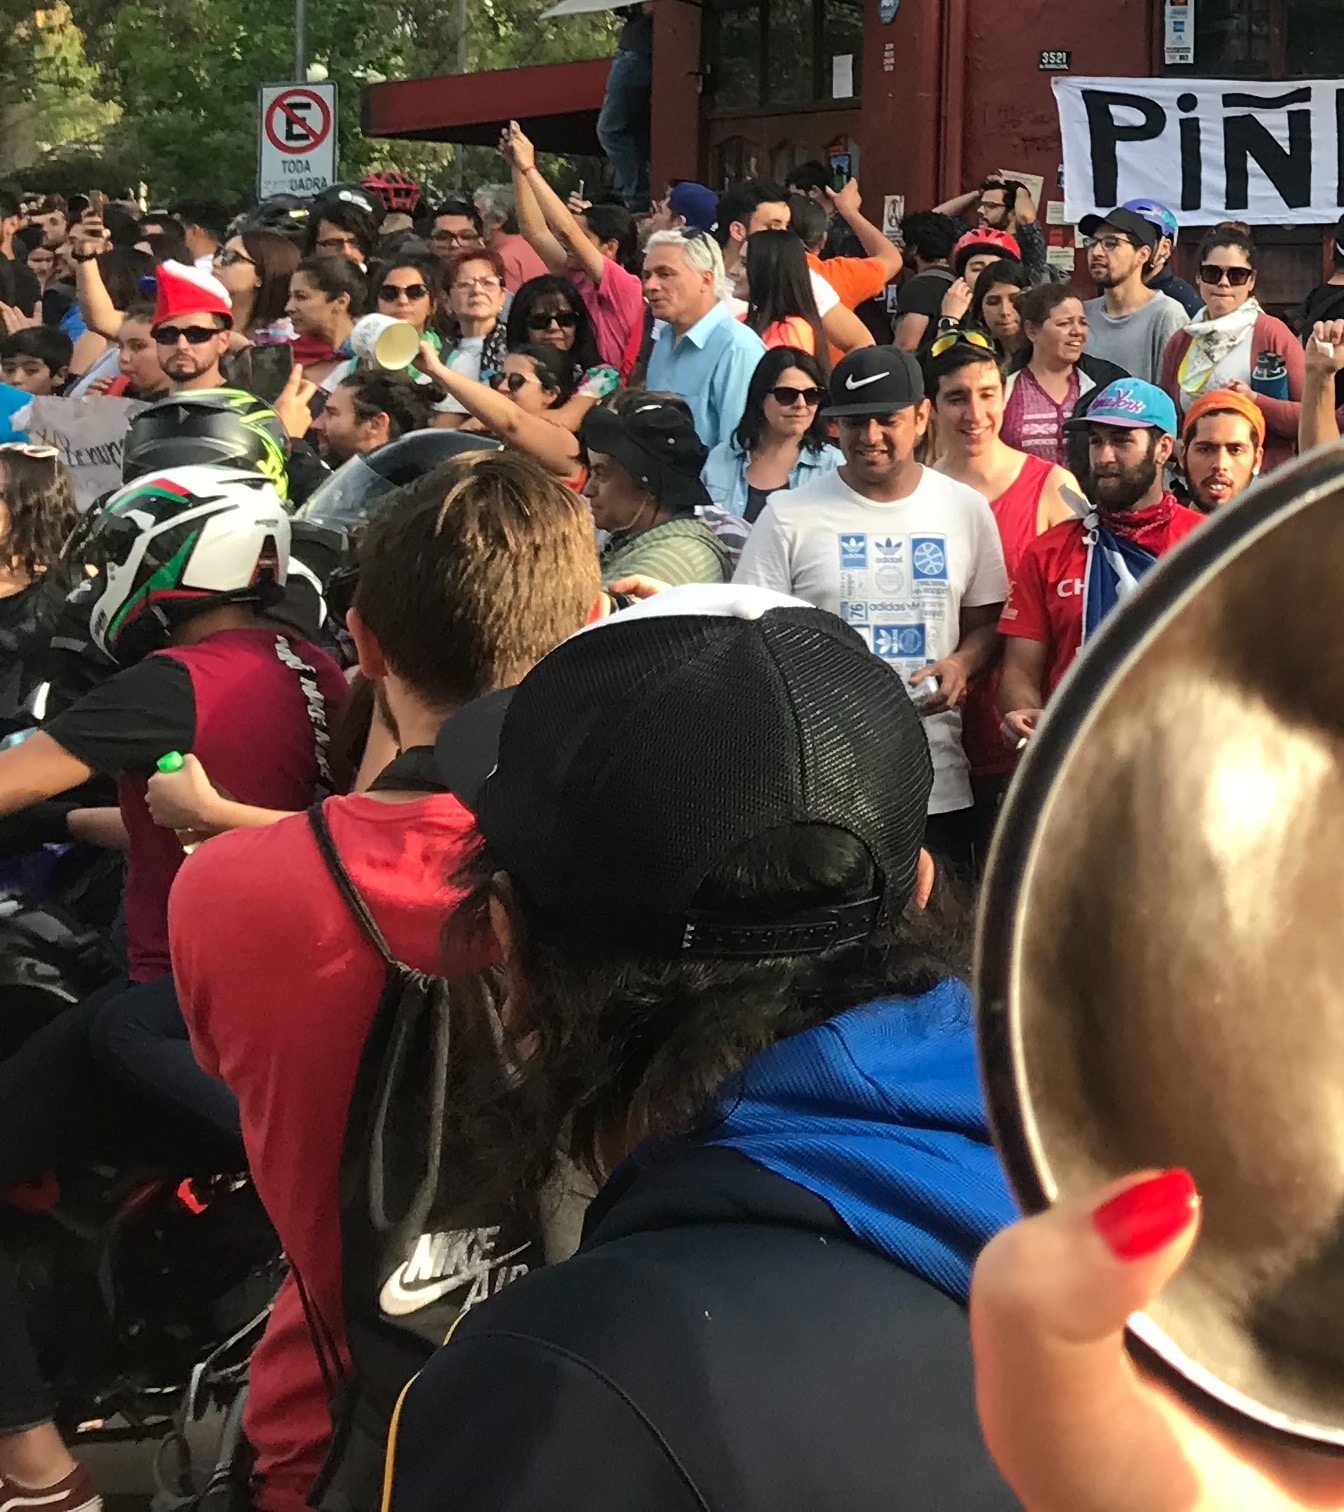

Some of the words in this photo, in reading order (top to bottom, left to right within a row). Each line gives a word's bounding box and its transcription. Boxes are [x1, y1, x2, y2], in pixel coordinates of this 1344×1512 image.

[1041, 51, 1067, 64] 3521
[281, 159, 311, 175] TODA
[289, 175, 328, 192] UADRA
[869, 601, 907, 612] adidas
[403, 1225, 501, 1284] NIKE
